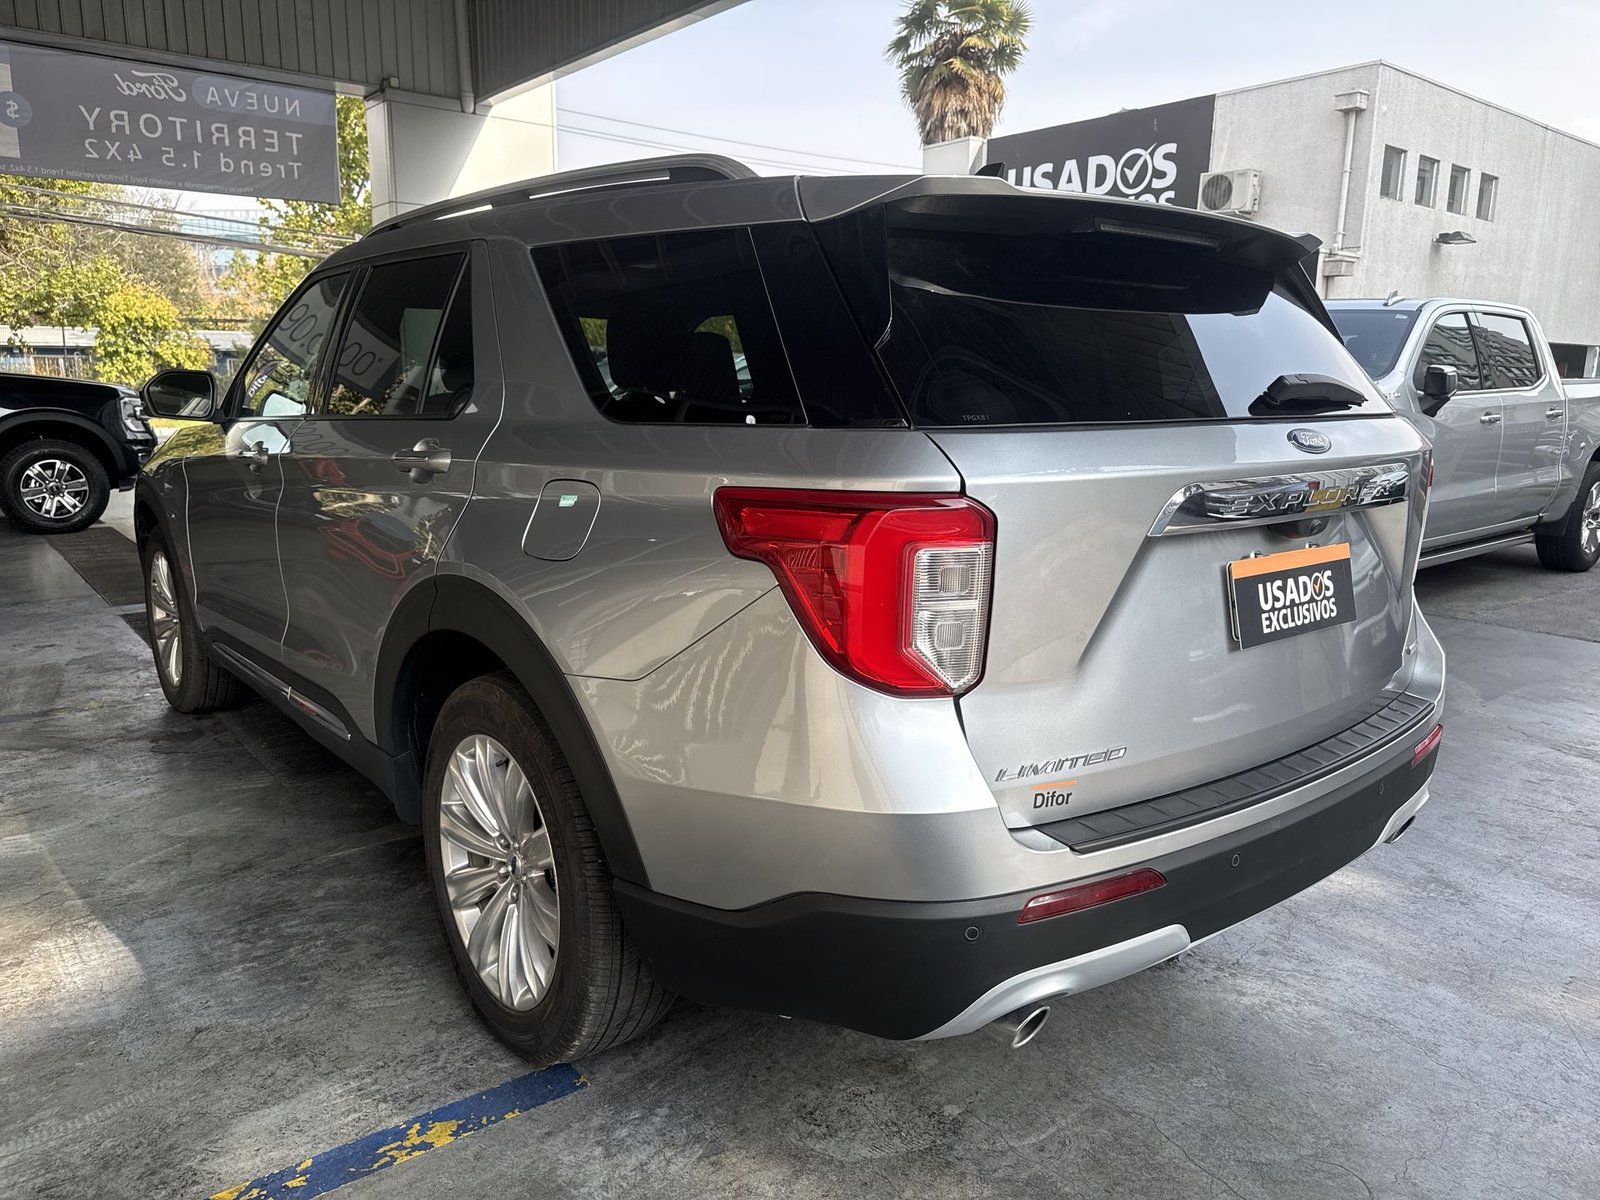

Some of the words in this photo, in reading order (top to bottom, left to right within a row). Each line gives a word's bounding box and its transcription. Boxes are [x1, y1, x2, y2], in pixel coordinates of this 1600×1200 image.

[1007, 142, 1178, 195] USADOS
[1231, 478, 1391, 515] EXPLORER
[1257, 569, 1335, 611] USADOS
[1261, 597, 1338, 634] EXCLUSIVOS
[994, 746, 1128, 782] LIMITED
[1033, 790, 1073, 809] Difor
